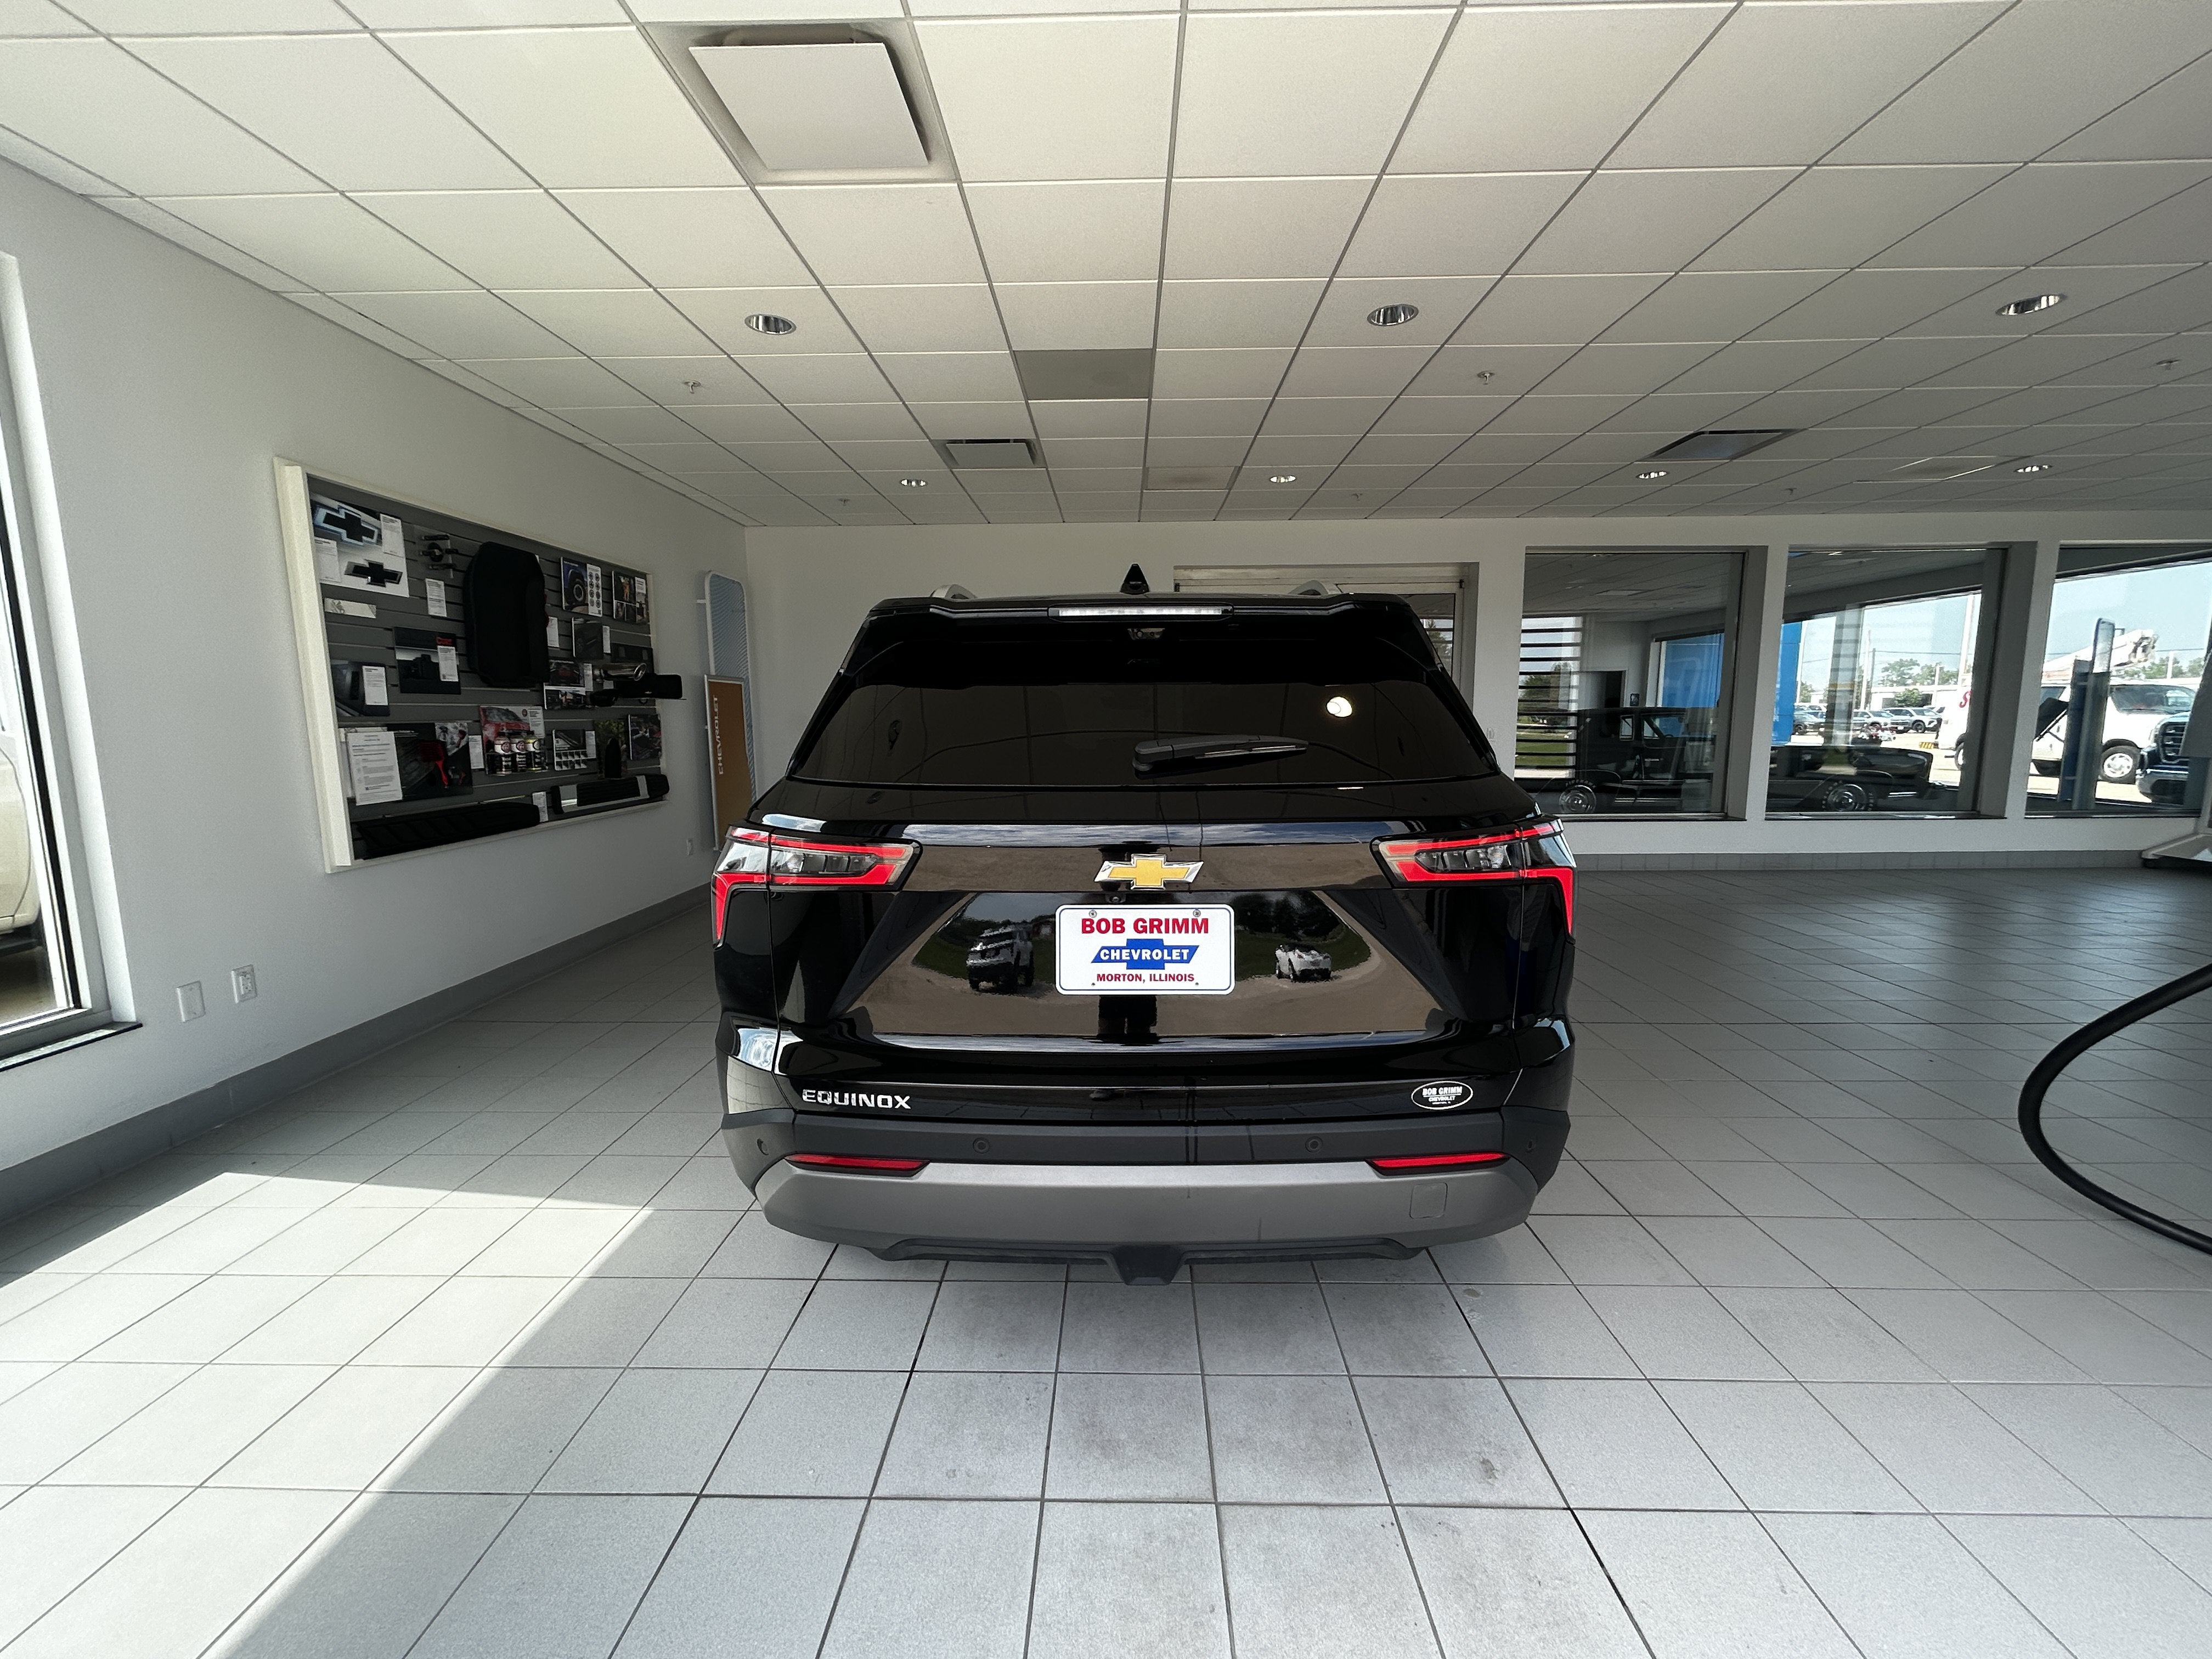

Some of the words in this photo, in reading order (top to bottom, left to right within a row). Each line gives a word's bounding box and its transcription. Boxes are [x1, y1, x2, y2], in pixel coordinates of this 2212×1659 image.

[713, 695, 723, 775] CHEVROLET
[1081, 918, 1125, 934] BOB
[1133, 918, 1209, 934] GRIMM
[1100, 949, 1189, 960] CHEVROLET
[1096, 974, 1146, 983] MORTON,
[1149, 973, 1194, 982] ILLINOIS
[1423, 1087, 1437, 1096] BOB
[1438, 1086, 1463, 1095] GRIMM
[802, 1089, 911, 1109] EQUINOX
